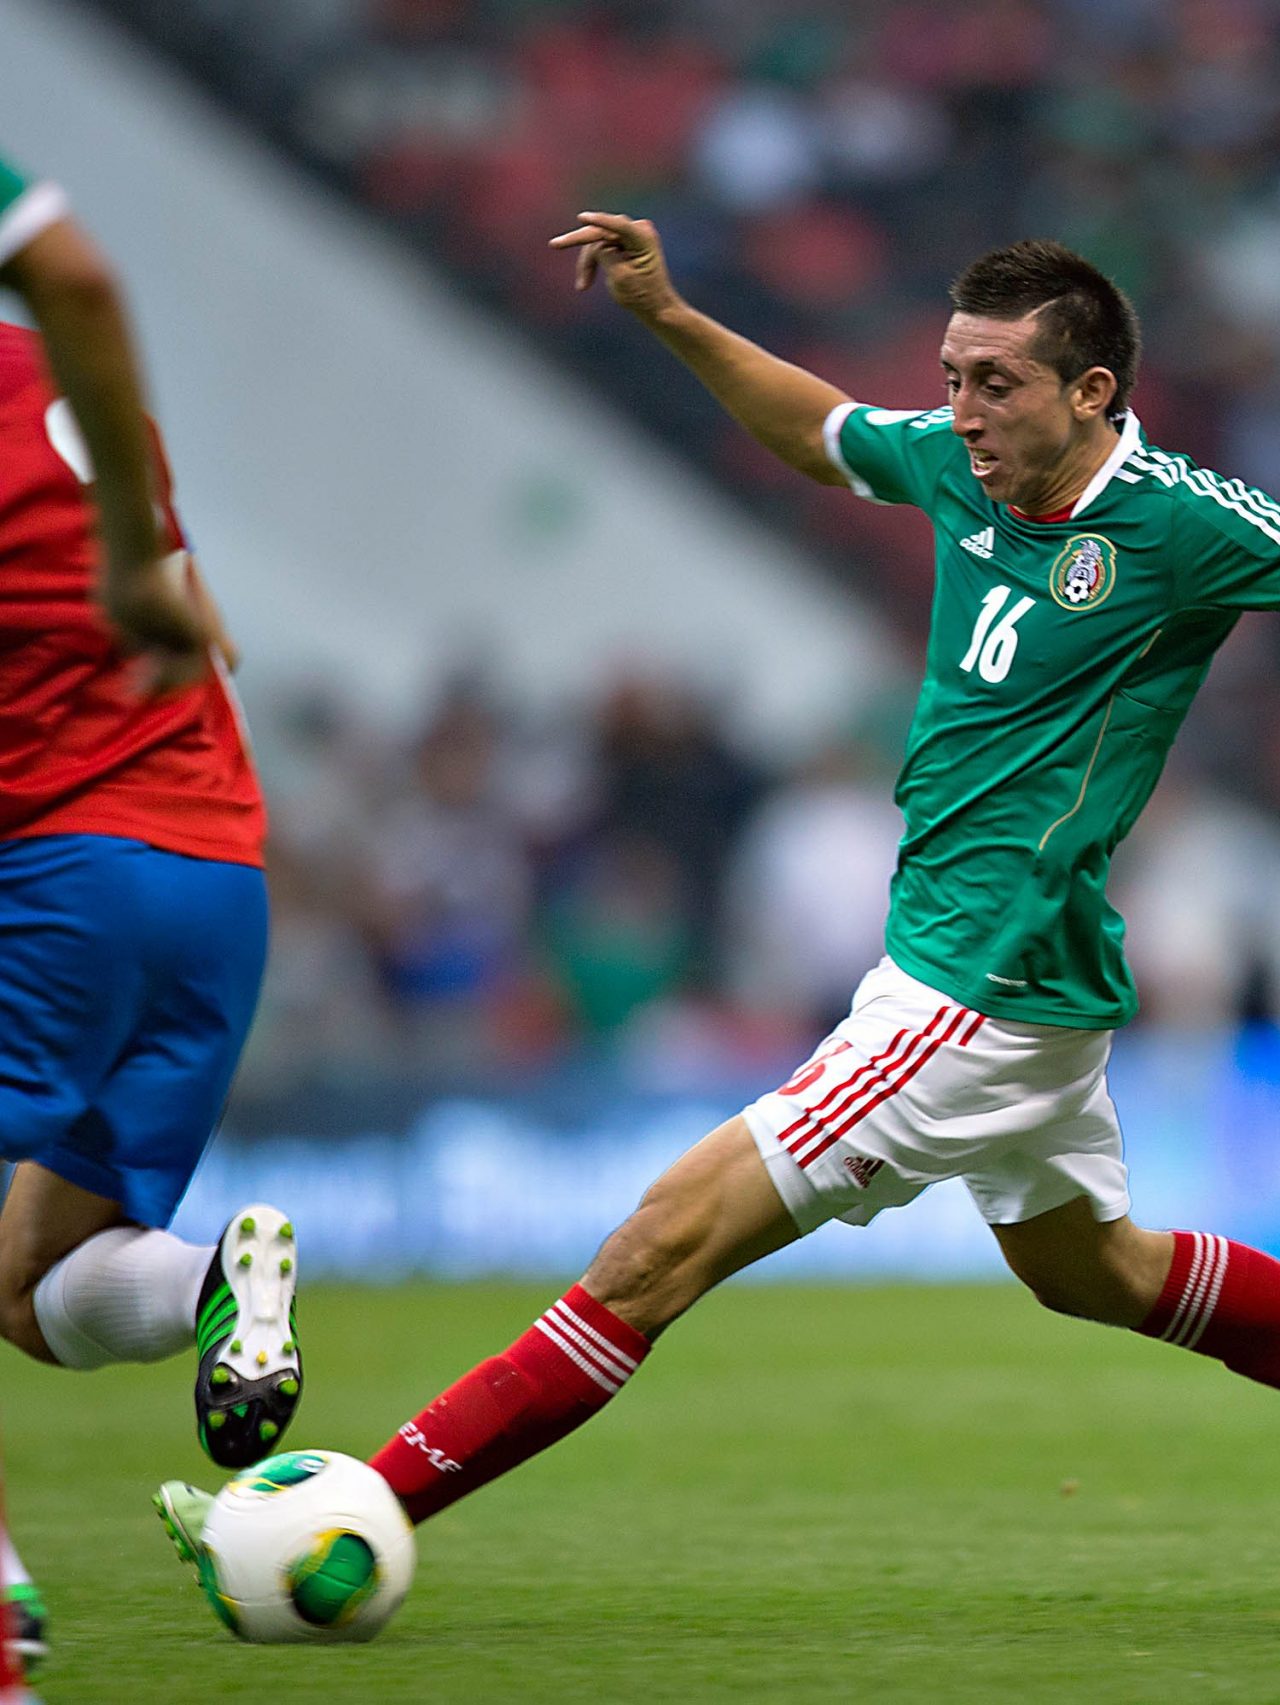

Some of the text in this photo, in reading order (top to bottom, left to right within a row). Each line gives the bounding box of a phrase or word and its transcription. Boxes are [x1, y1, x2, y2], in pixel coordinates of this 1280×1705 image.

[959, 537, 994, 559] adidas
[959, 585, 1037, 684] 16
[843, 1156, 870, 1189] adidas
